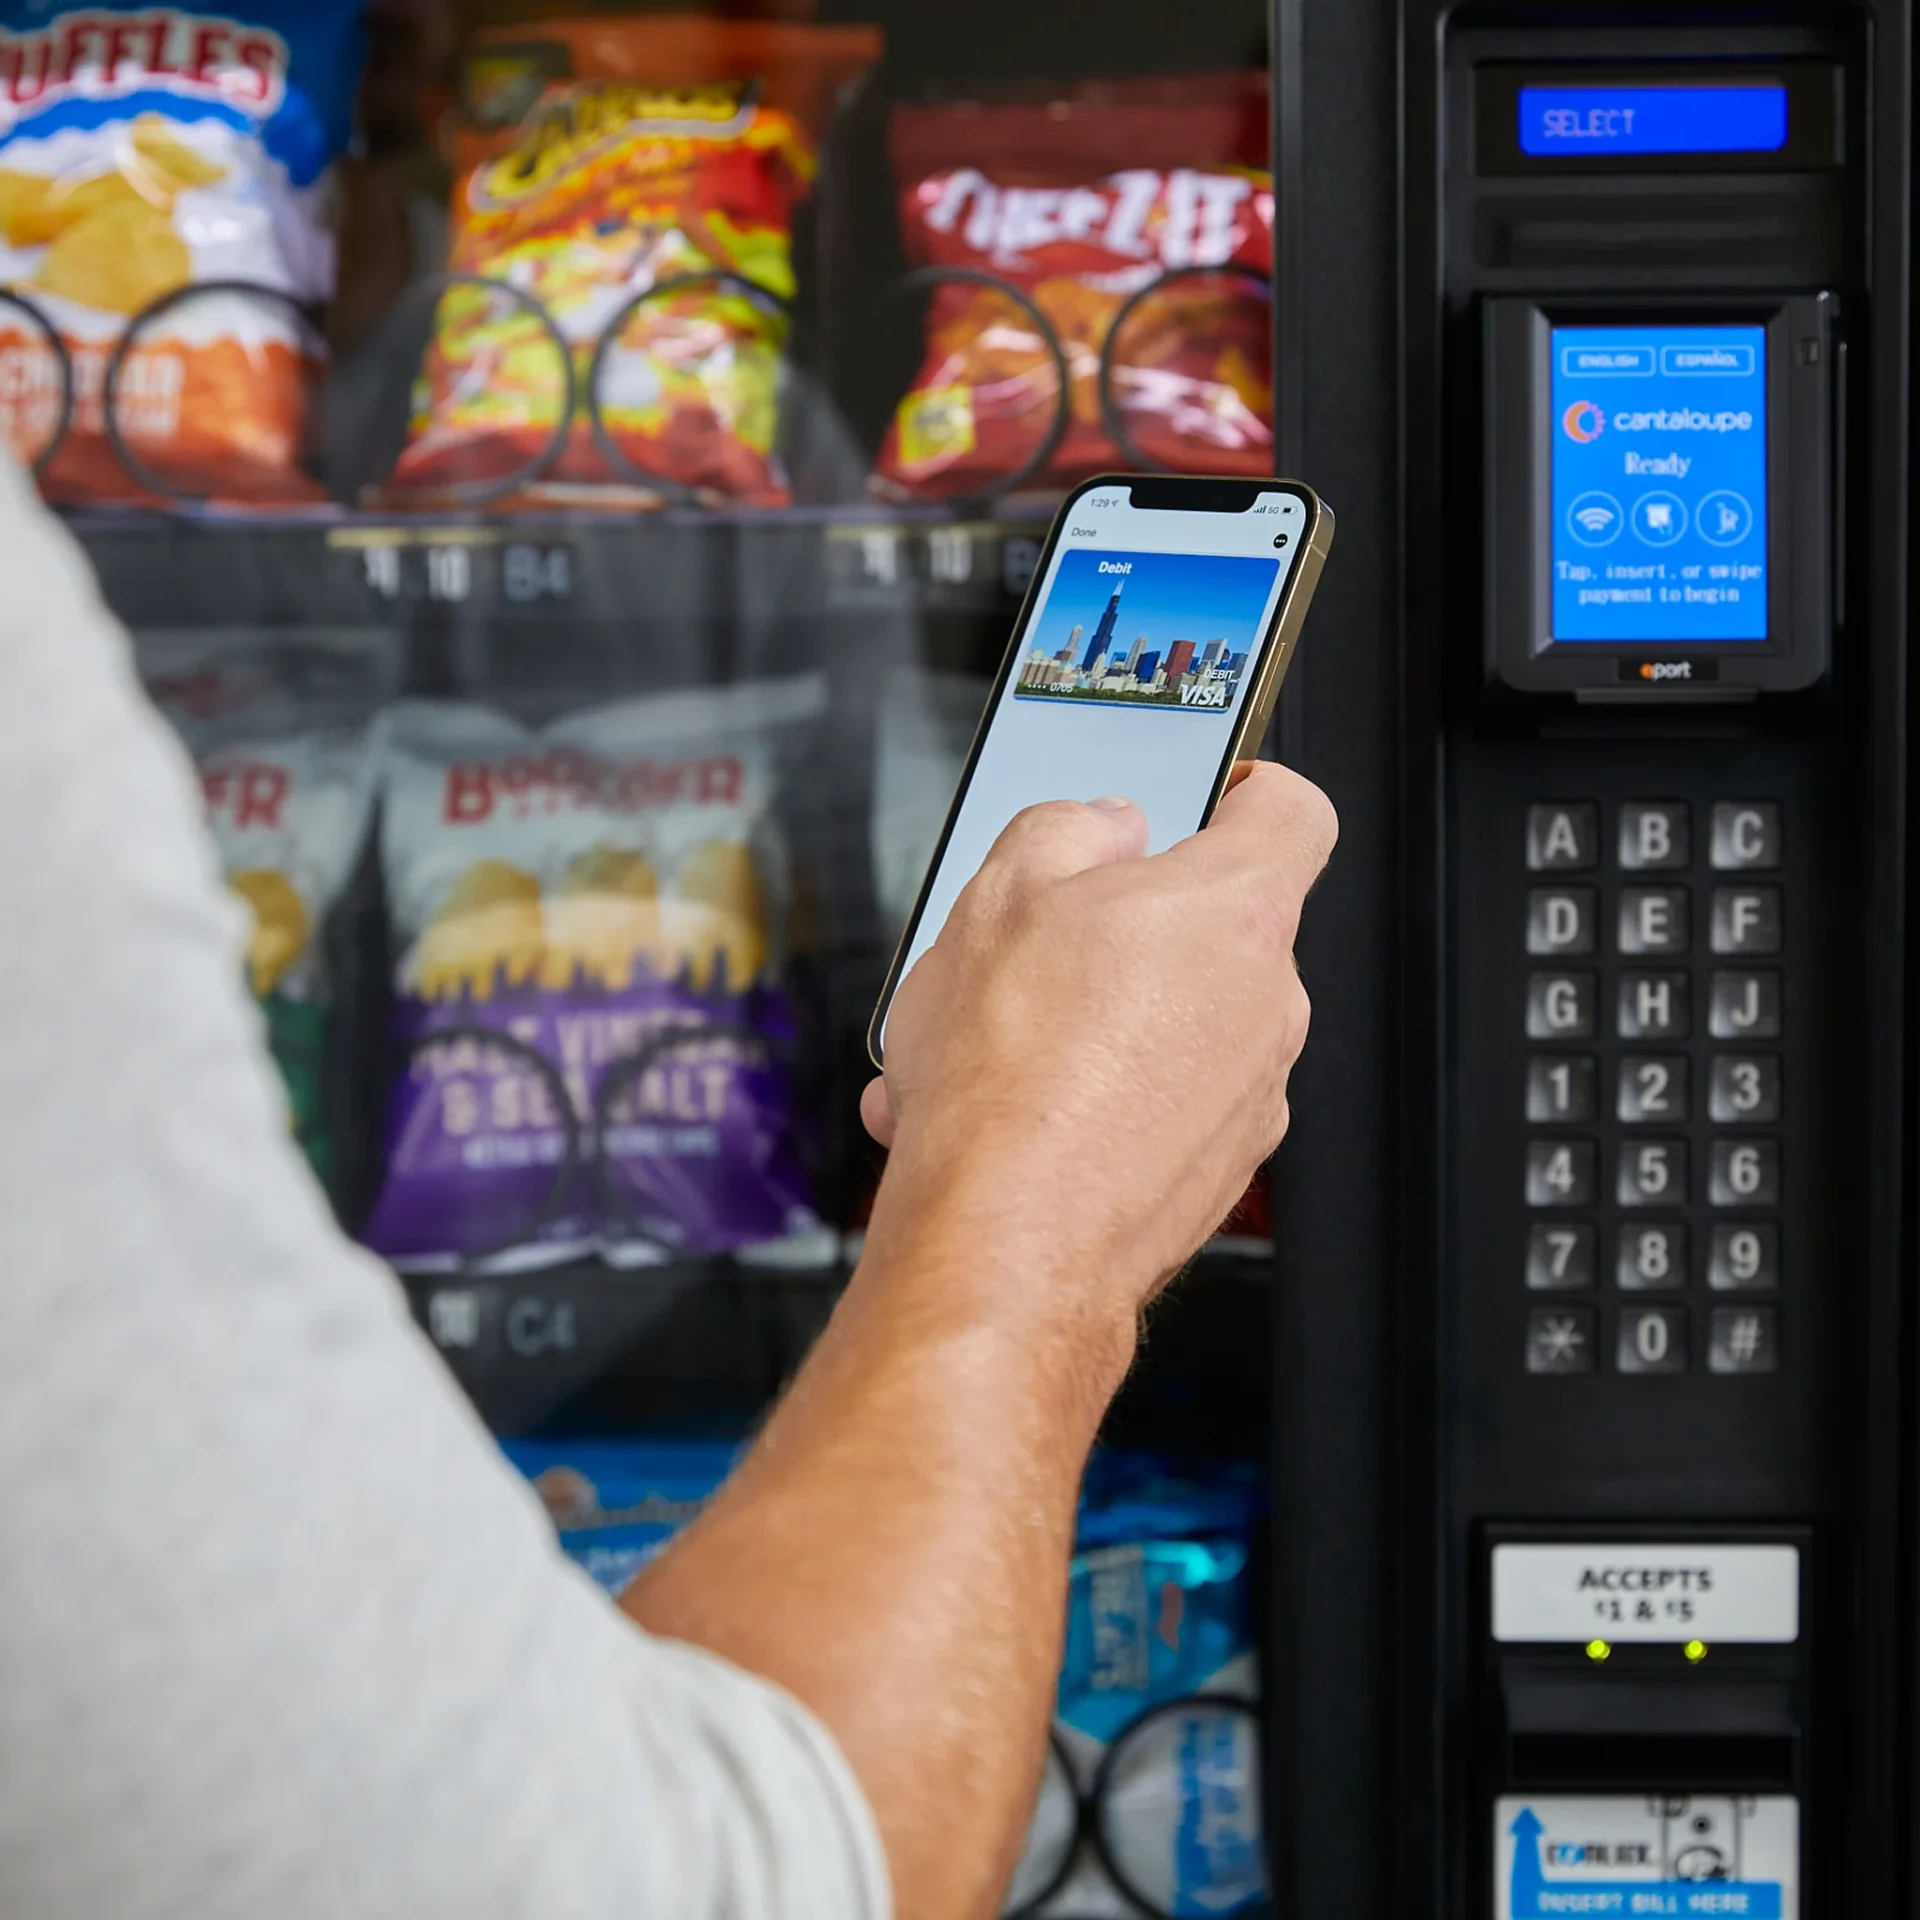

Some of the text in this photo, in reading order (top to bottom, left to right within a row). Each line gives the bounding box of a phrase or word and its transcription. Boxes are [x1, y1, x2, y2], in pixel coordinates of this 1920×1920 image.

[0, 14, 281, 105] UFFLES
[1543, 109, 1635, 137] SELECT
[1578, 354, 1639, 368] ENGLISH
[1675, 350, 1740, 368] ESPAÑOL
[1613, 408, 1753, 433] cantaloupe
[1624, 452, 1692, 479] Ready
[1091, 498, 1110, 508] 1:29
[1267, 506, 1280, 514] 5G
[1071, 527, 1097, 538] Done
[1098, 561, 1133, 575] Debit
[1556, 561, 1598, 582] Tap,
[1681, 565, 1703, 579] or
[1709, 562, 1763, 581] swipe
[1578, 585, 1740, 605] payment to begin
[1203, 669, 1236, 680] DEBIT
[1640, 661, 1692, 681] eport
[1180, 684, 1227, 707] VISA
[1544, 810, 1764, 860] A B C
[1546, 896, 1761, 945] D E F
[1545, 979, 1759, 1028] G H J
[1549, 1063, 1761, 1111] 1 2 3
[1545, 1146, 1761, 1194] 4 5 6
[1546, 1231, 1760, 1279] 7 8 9
[1638, 1314, 1668, 1361] 0
[1578, 1568, 1714, 1592] ACCEPTS
